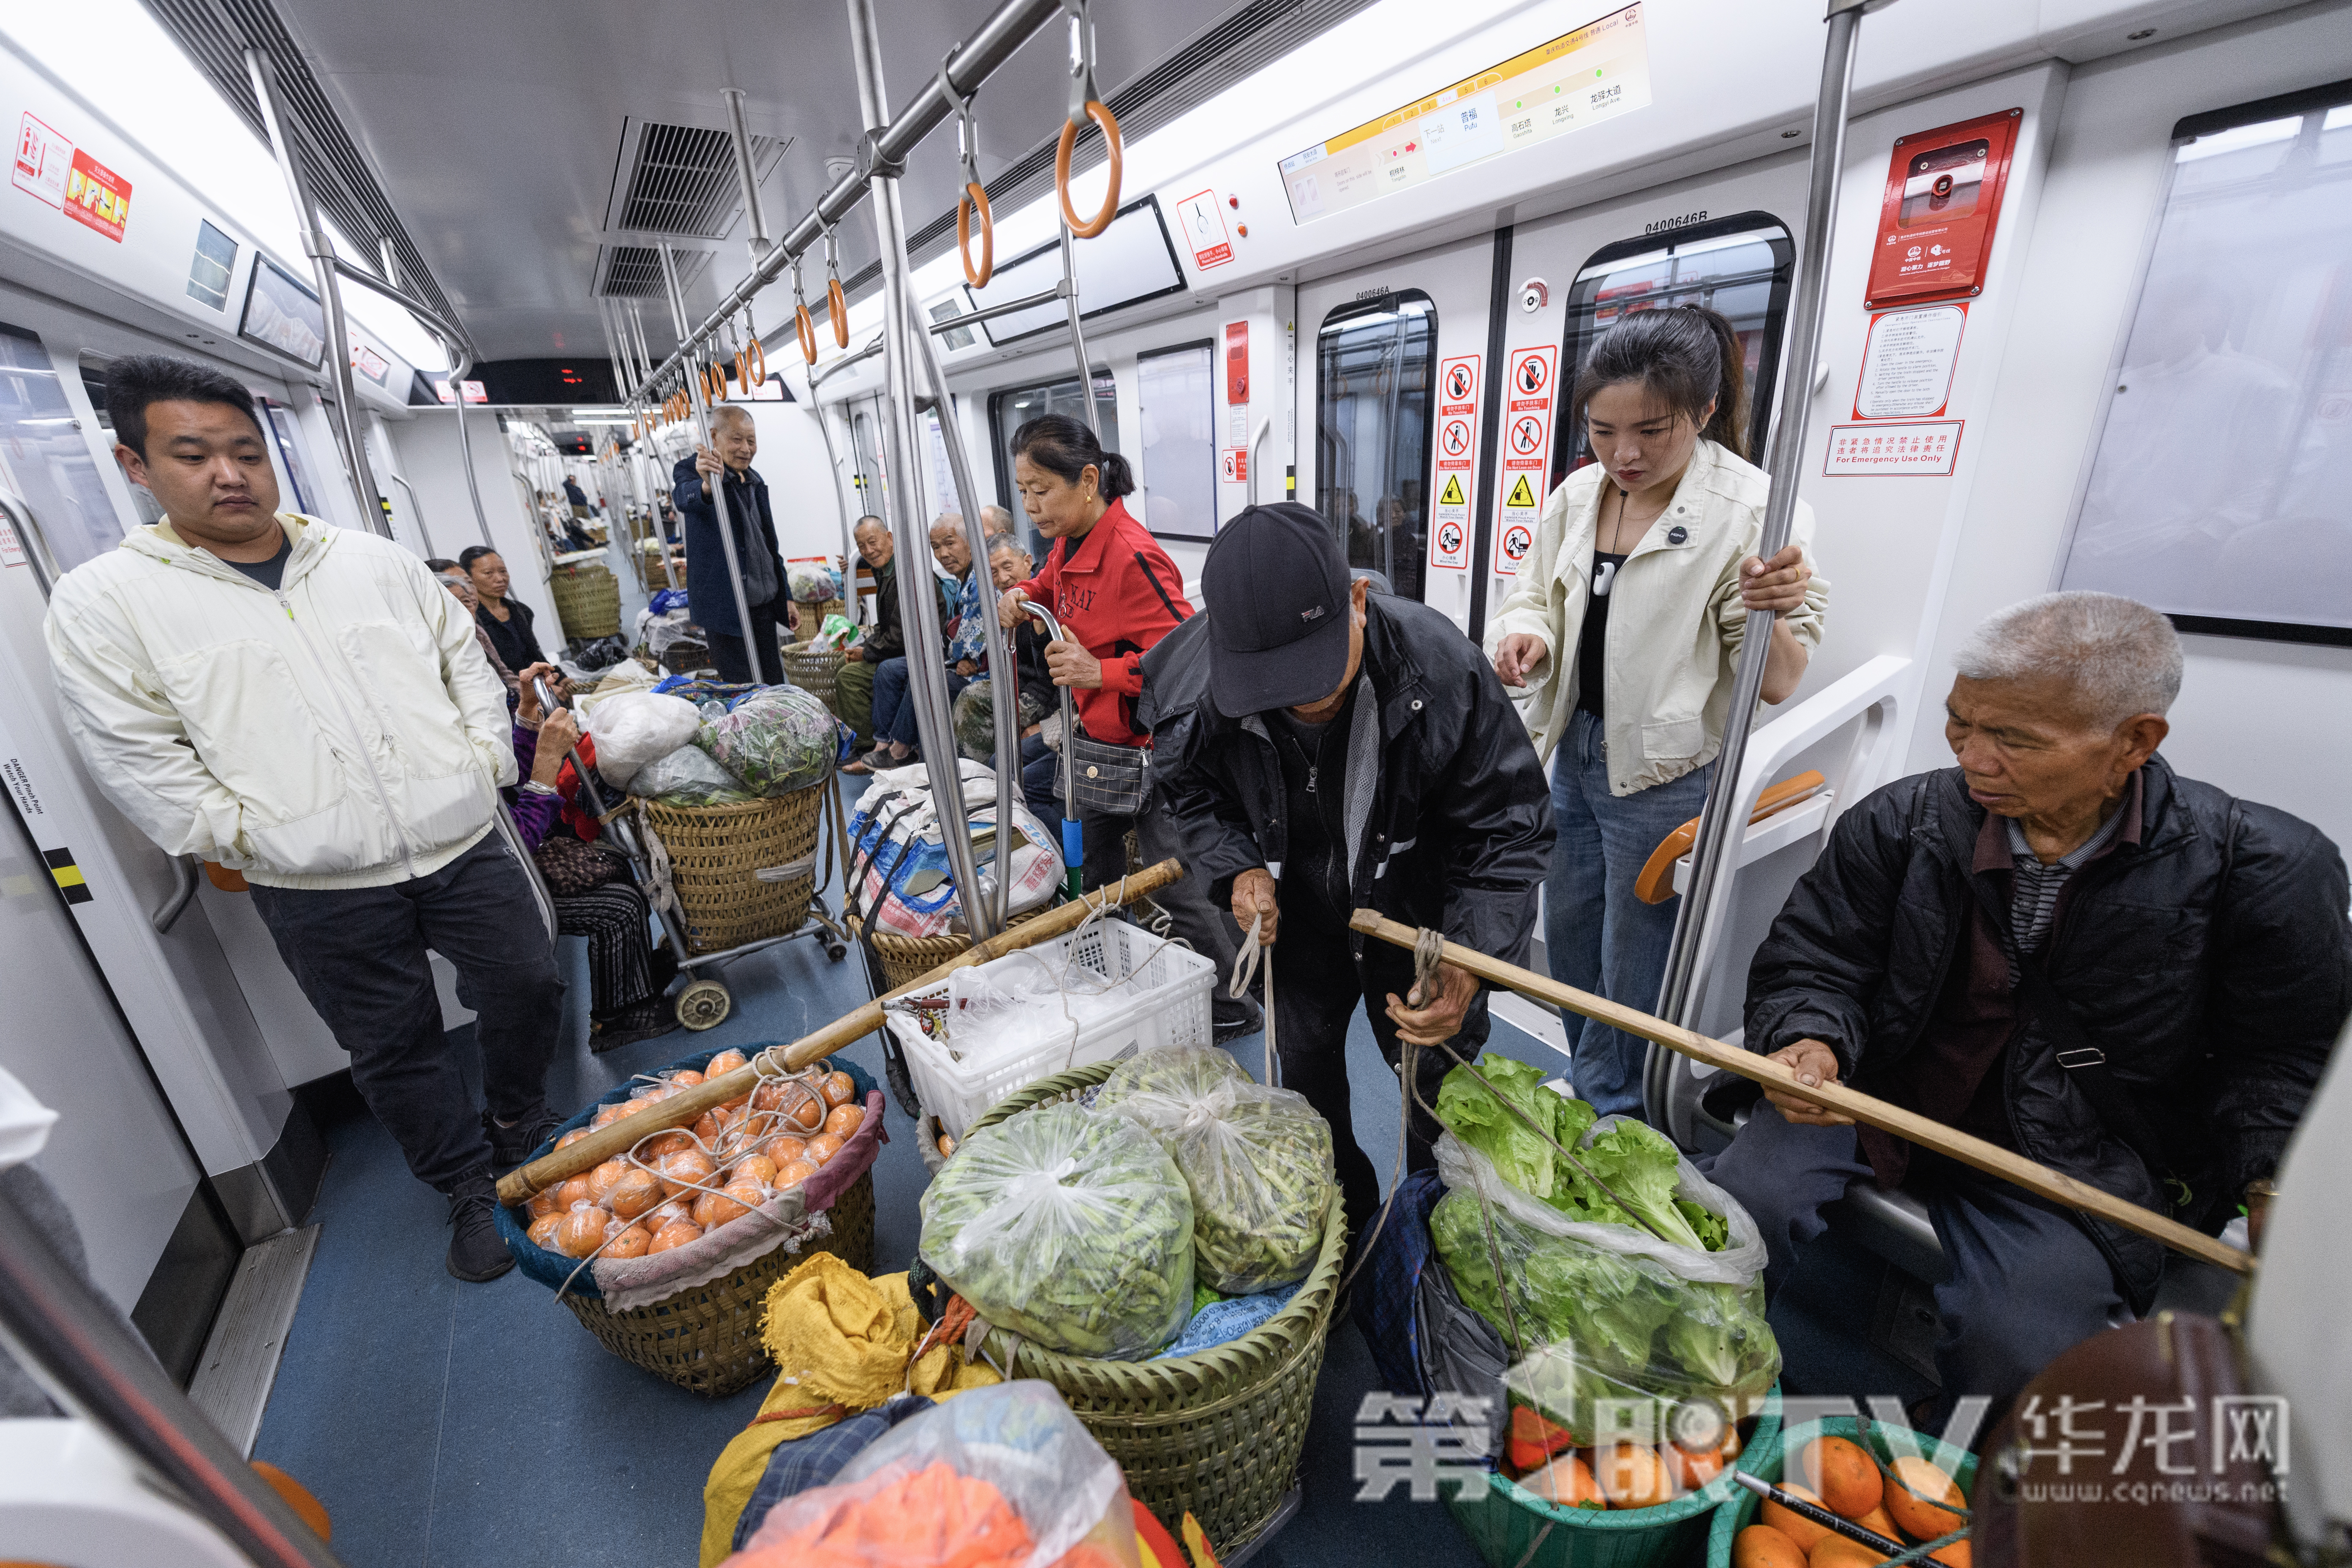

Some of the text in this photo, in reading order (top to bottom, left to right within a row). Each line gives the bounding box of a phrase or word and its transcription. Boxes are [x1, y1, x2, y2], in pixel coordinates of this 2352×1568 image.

[1602, 19, 1618, 31] Local
[1591, 85, 1621, 104] 龙驿大道
[1554, 105, 1569, 117] 龙兴
[1592, 101, 1609, 110] Longyi
[1461, 108, 1477, 123] 普福
[1553, 114, 1573, 125] Longxing
[1424, 123, 1444, 139] 下一站
[1465, 122, 1477, 131] Pufu
[1511, 119, 1531, 133] 高石塔
[1514, 129, 1532, 139] Gaoshita
[1303, 149, 1317, 160] 民安大道
[1284, 161, 1295, 170] 终点站
[1390, 166, 1405, 177] 桐梓林
[1645, 211, 1707, 234] 0400646B
[1356, 286, 1389, 300] 0400646A
[1839, 435, 1947, 446] 非紧急情况禁止使用
[1837, 444, 1944, 455] 违者将追究法律责任
[1070, 584, 1096, 611] KAY
[1301, 606, 1324, 622] FILA
[3, 764, 32, 814] Watch Your Hands
[10, 759, 43, 814] DANGER Pinch Point
